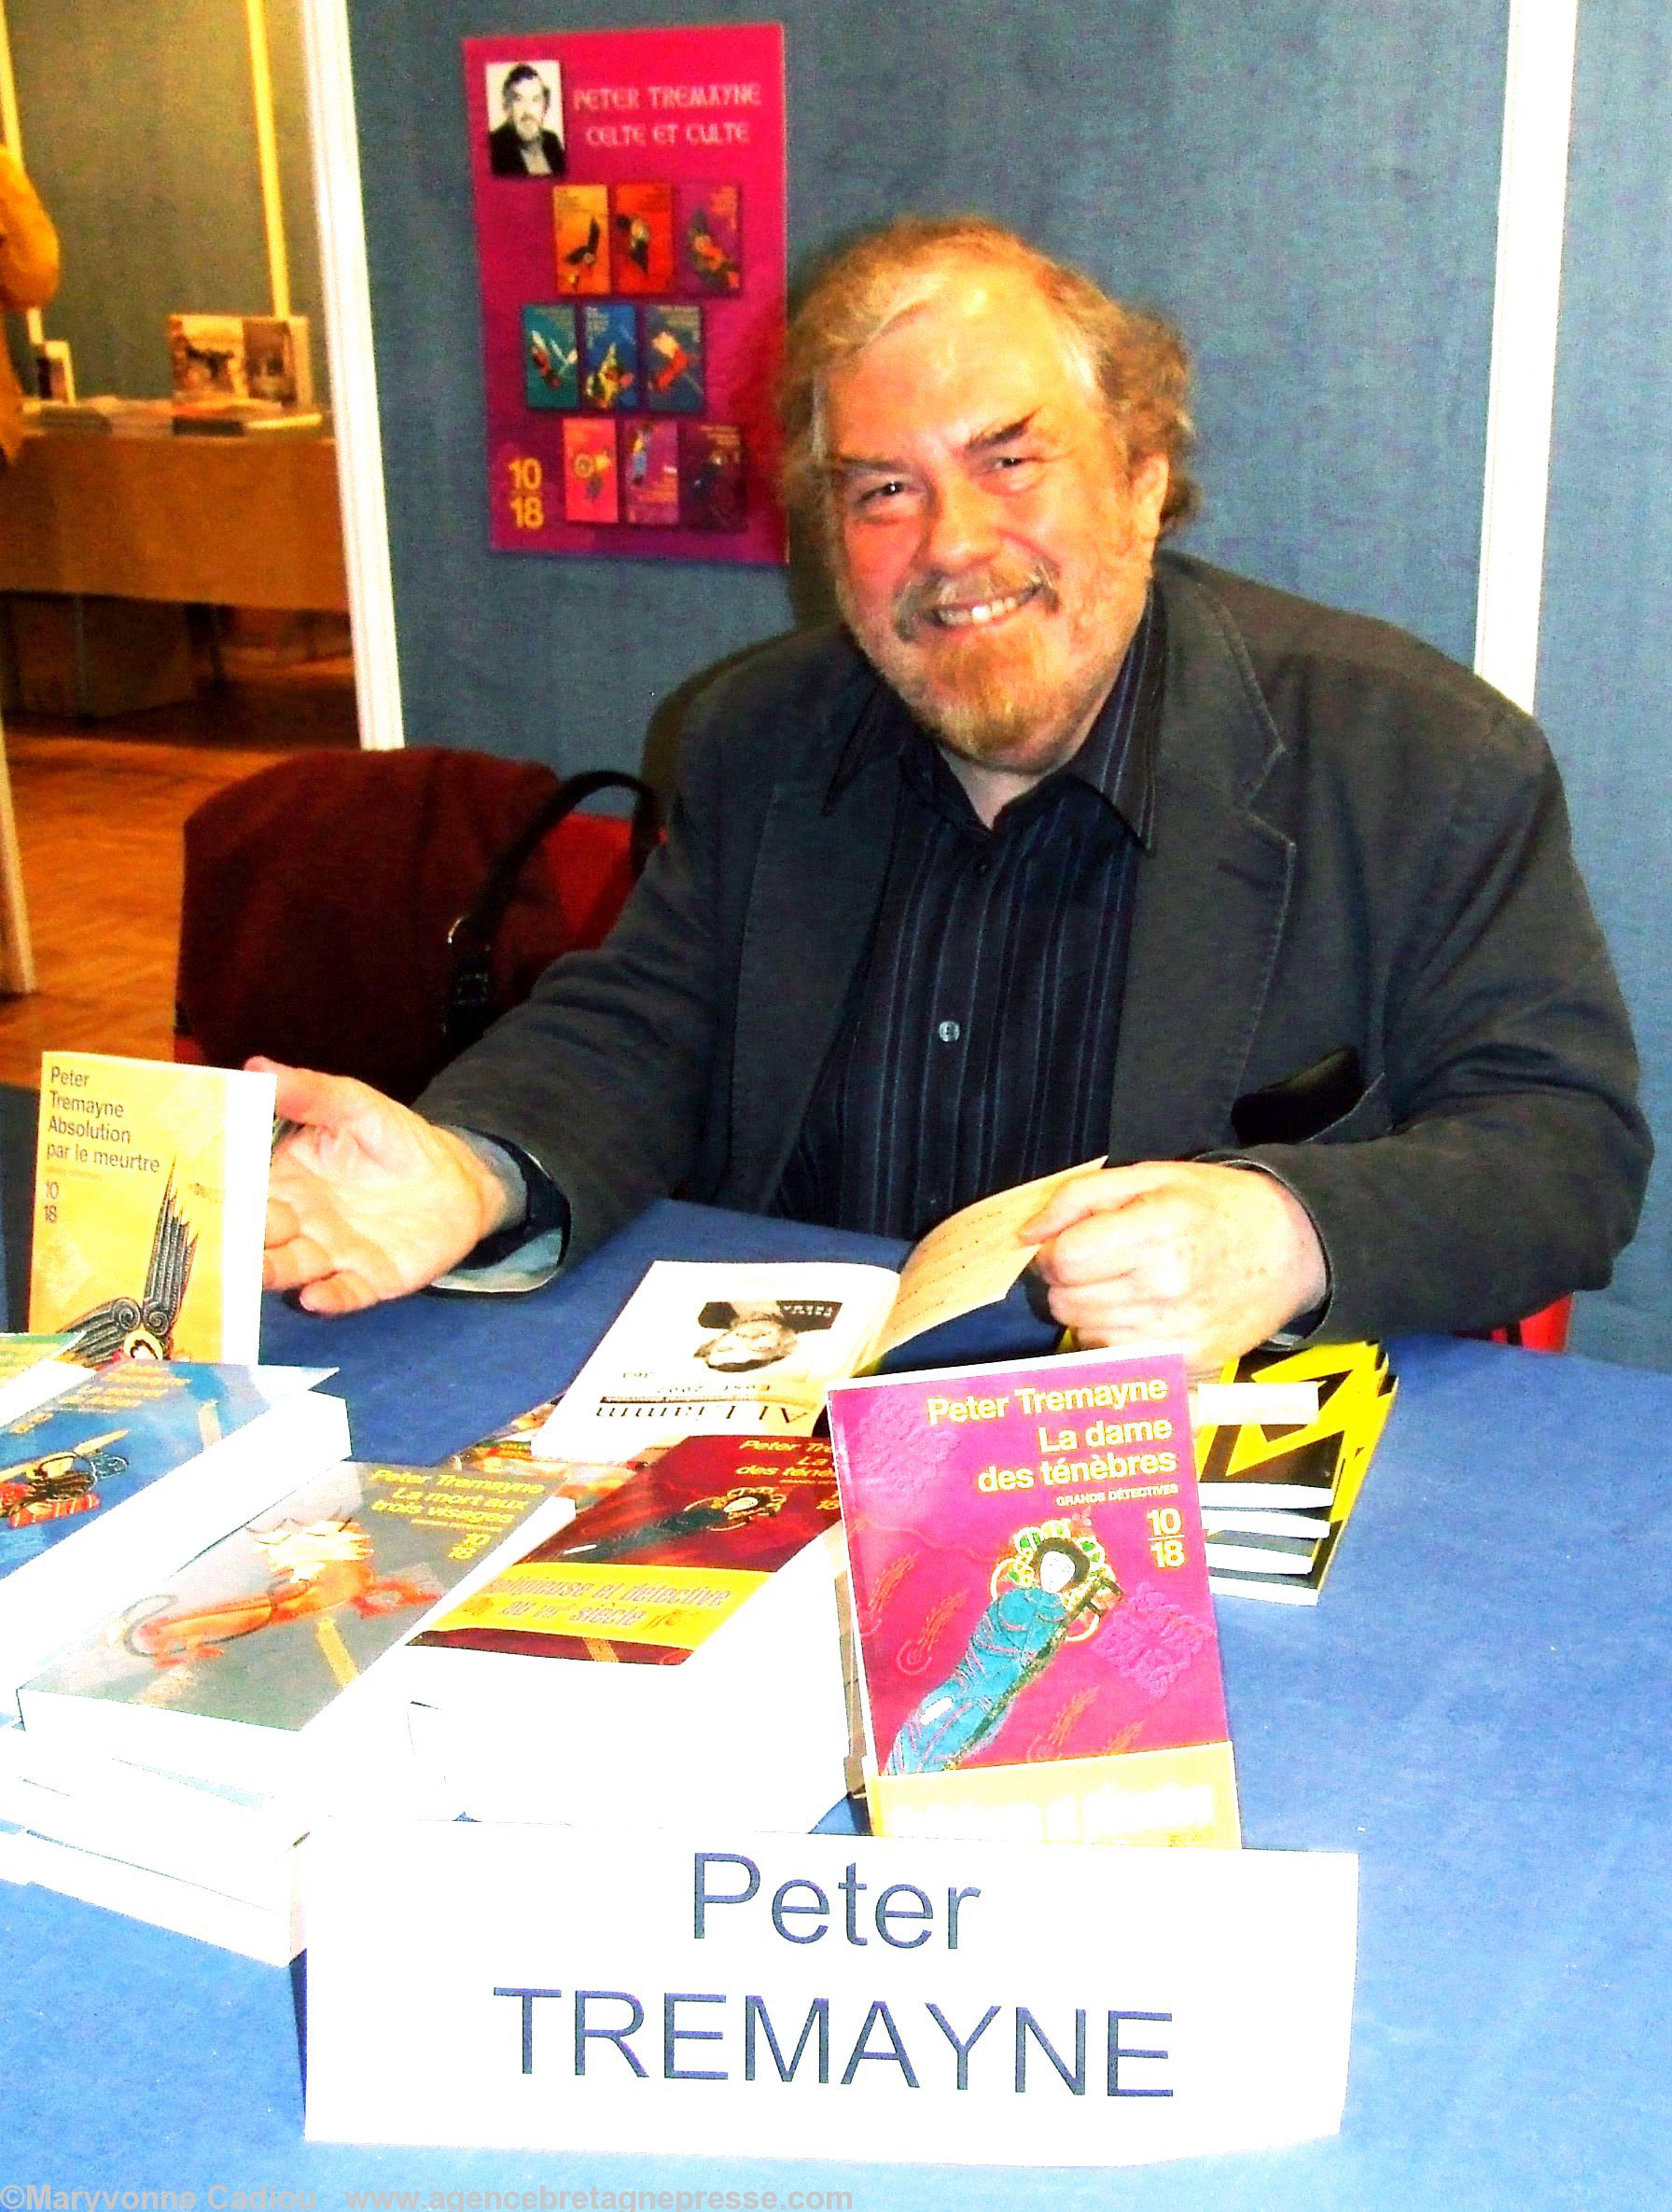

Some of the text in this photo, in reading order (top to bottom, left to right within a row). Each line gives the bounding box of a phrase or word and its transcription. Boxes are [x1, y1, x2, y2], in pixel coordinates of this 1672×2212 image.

[572, 83, 761, 111] PETER TREMAYNE
[653, 123, 678, 145] ET
[509, 457, 543, 490] 10
[509, 496, 545, 530] 18
[50, 1065, 90, 1087] Peter
[49, 1090, 124, 1119] Tremayne
[49, 1115, 132, 1144] Absolution
[47, 1143, 70, 1160] par
[76, 1144, 88, 1162] le
[93, 1150, 160, 1173] meurtre
[45, 1180, 59, 1200] 10
[44, 1204, 57, 1224] 18
[927, 1378, 1168, 1426] Peter Tremayne
[739, 1440, 801, 1452] Peter
[1038, 1418, 1173, 1454] La dame
[797, 1455, 829, 1466] La
[978, 1451, 1177, 1493] des ténèbres
[369, 1468, 432, 1483] Peter
[1055, 1491, 1106, 1507] GRANDS
[1146, 1507, 1182, 1537] 10
[1150, 1539, 1186, 1568] 18
[692, 1852, 982, 1950] Peter
[493, 1986, 1175, 2097] TREMAYNE
